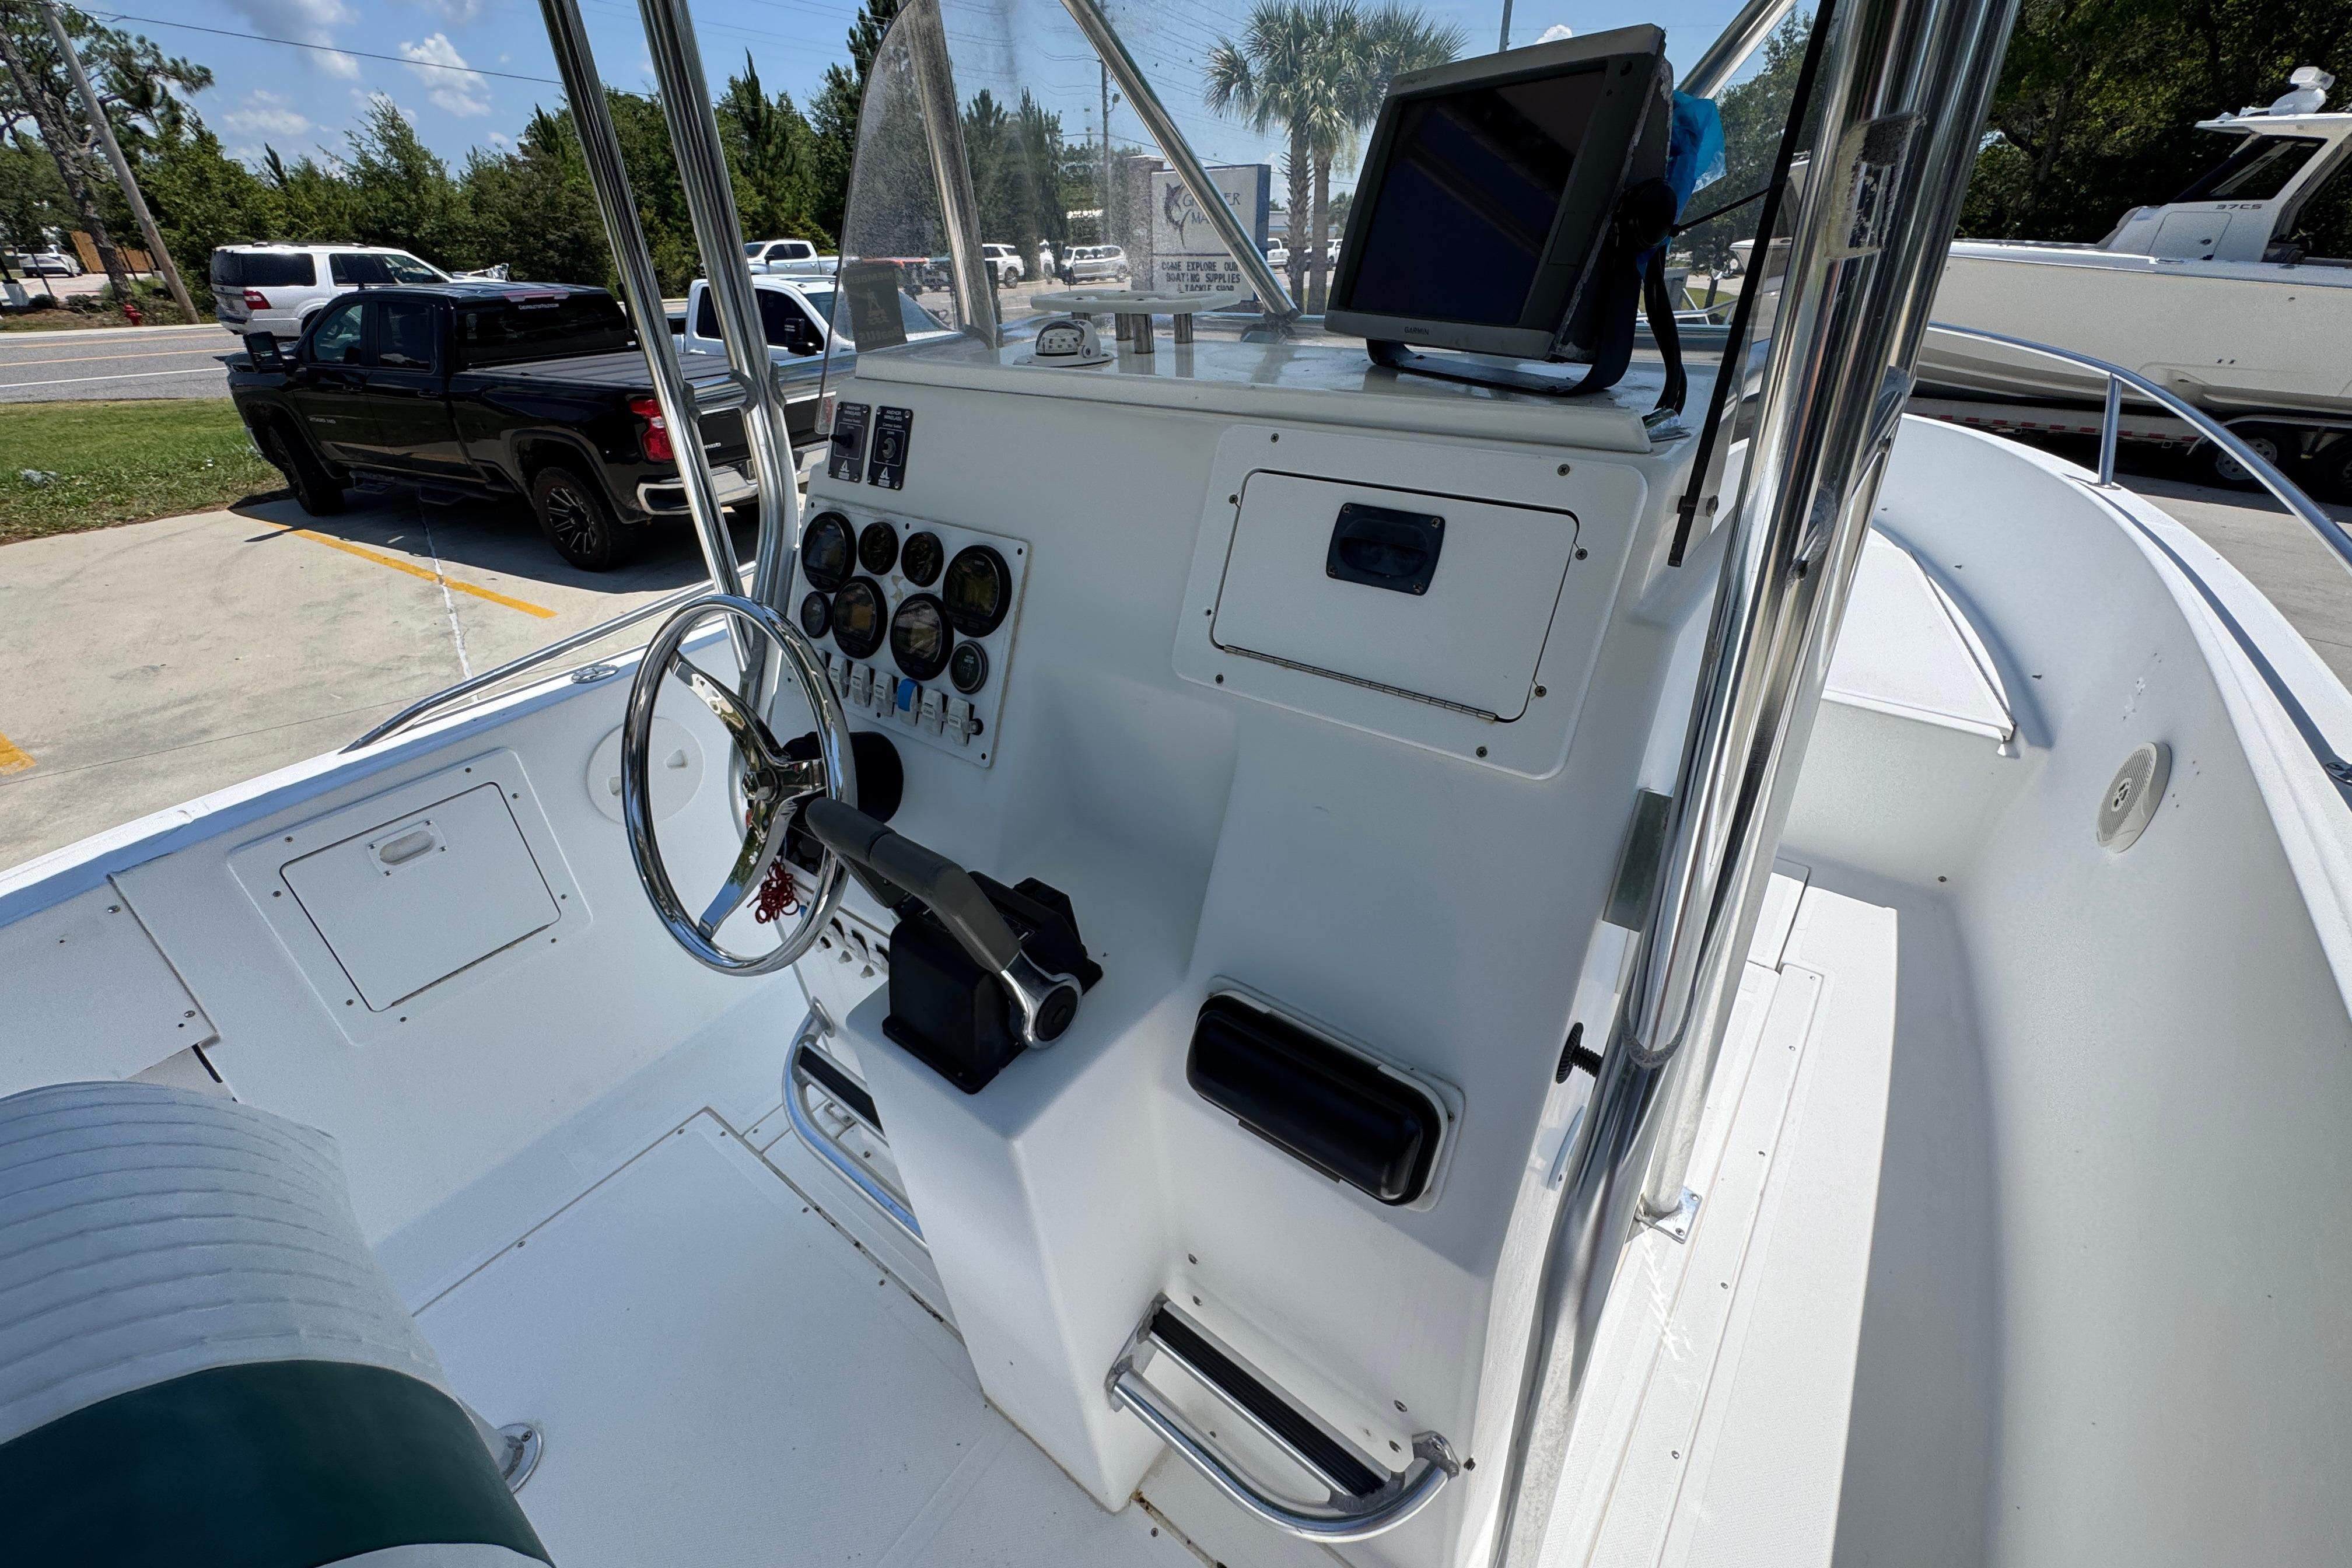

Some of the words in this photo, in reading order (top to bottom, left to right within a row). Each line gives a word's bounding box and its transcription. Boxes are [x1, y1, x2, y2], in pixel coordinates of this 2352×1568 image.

[1162, 261, 1181, 271] COME
[1186, 261, 1217, 271] EXPLORE
[1224, 261, 1238, 271] OUR
[1166, 272, 1200, 282] BOATING
[1206, 273, 1240, 283] SUPPLIES
[1404, 326, 1429, 335] GARMIN
